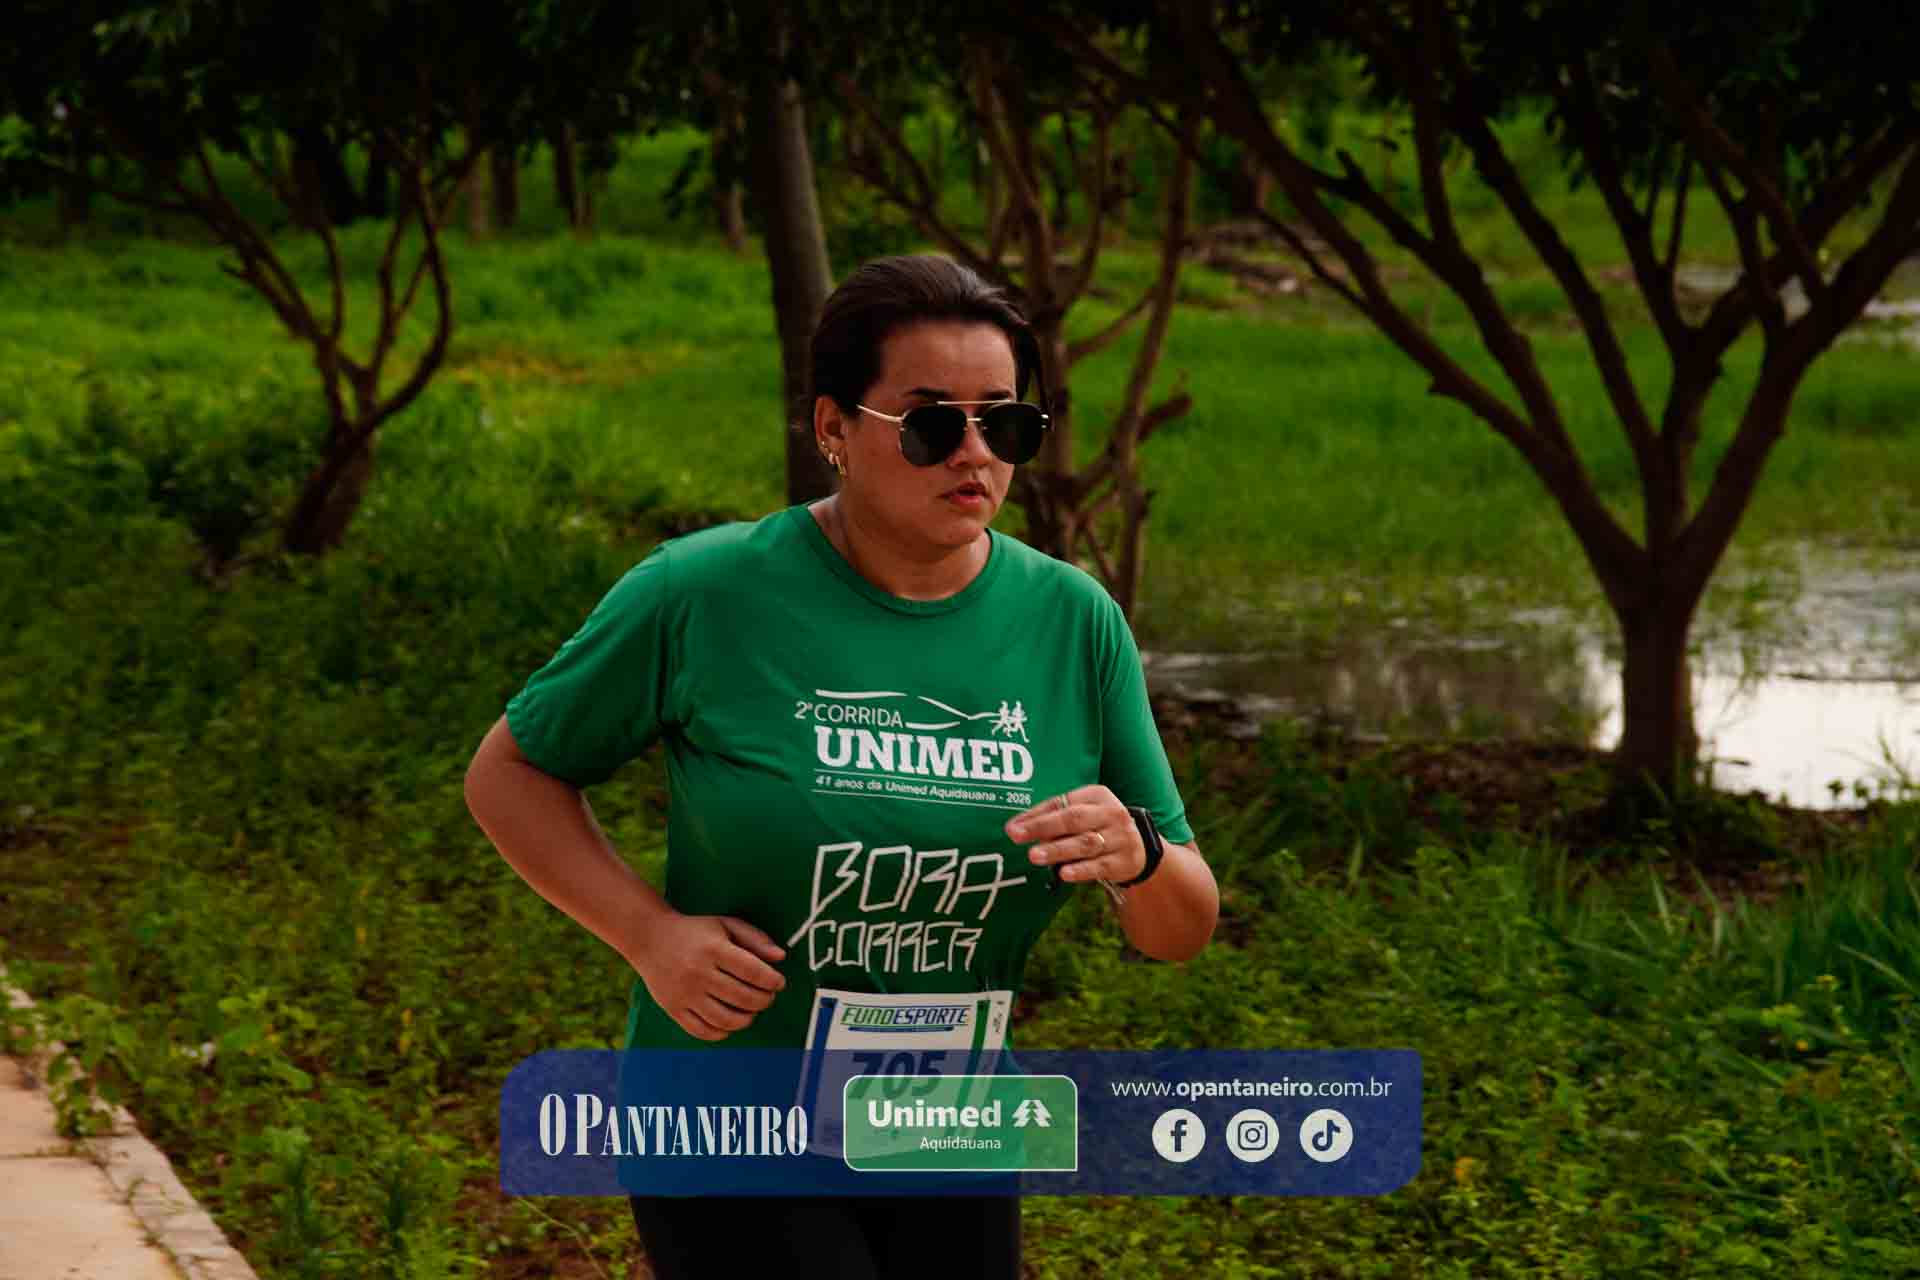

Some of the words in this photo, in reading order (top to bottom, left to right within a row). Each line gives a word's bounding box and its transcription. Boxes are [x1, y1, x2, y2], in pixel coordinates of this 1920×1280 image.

[814, 703, 904, 728] CORRIDA
[814, 725, 1034, 783] UNIMED
[816, 775, 832, 786] 41
[834, 779, 864, 790] anos
[885, 782, 928, 795] Unimed
[929, 785, 996, 802] Aquidauana
[787, 841, 1027, 947] BORA
[809, 919, 983, 973] CORRER
[840, 1007, 971, 1026] FUNDESPORTE
[849, 1052, 946, 1100] 705
